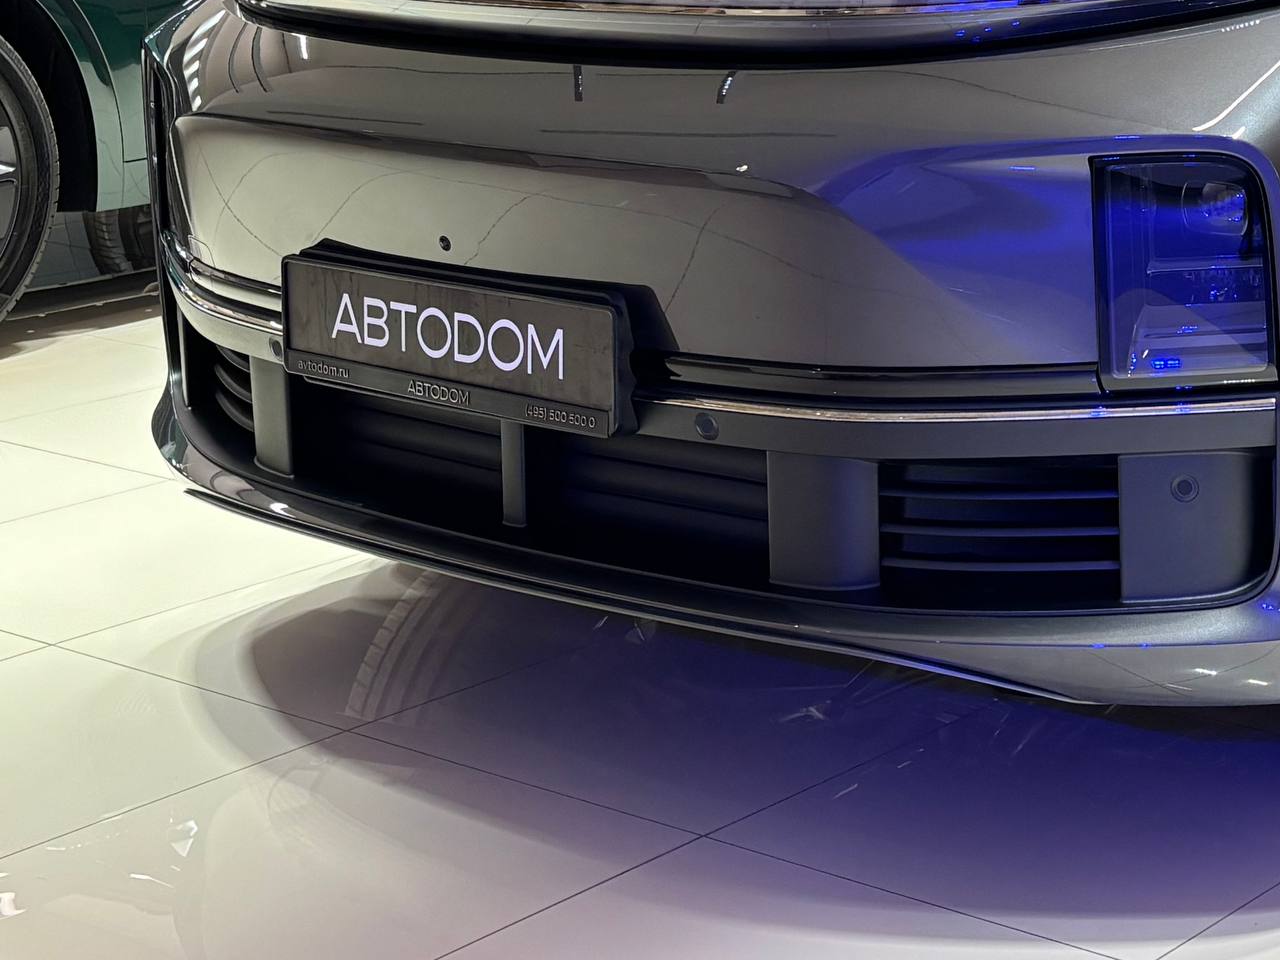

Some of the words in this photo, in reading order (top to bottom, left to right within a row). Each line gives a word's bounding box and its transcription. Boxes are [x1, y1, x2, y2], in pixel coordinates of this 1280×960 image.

[298, 359, 350, 378] avtodom.ru
[525, 403, 547, 420] (495)
[549, 409, 567, 423] 500
[568, 413, 586, 427] 500
[588, 417, 596, 428] 0
